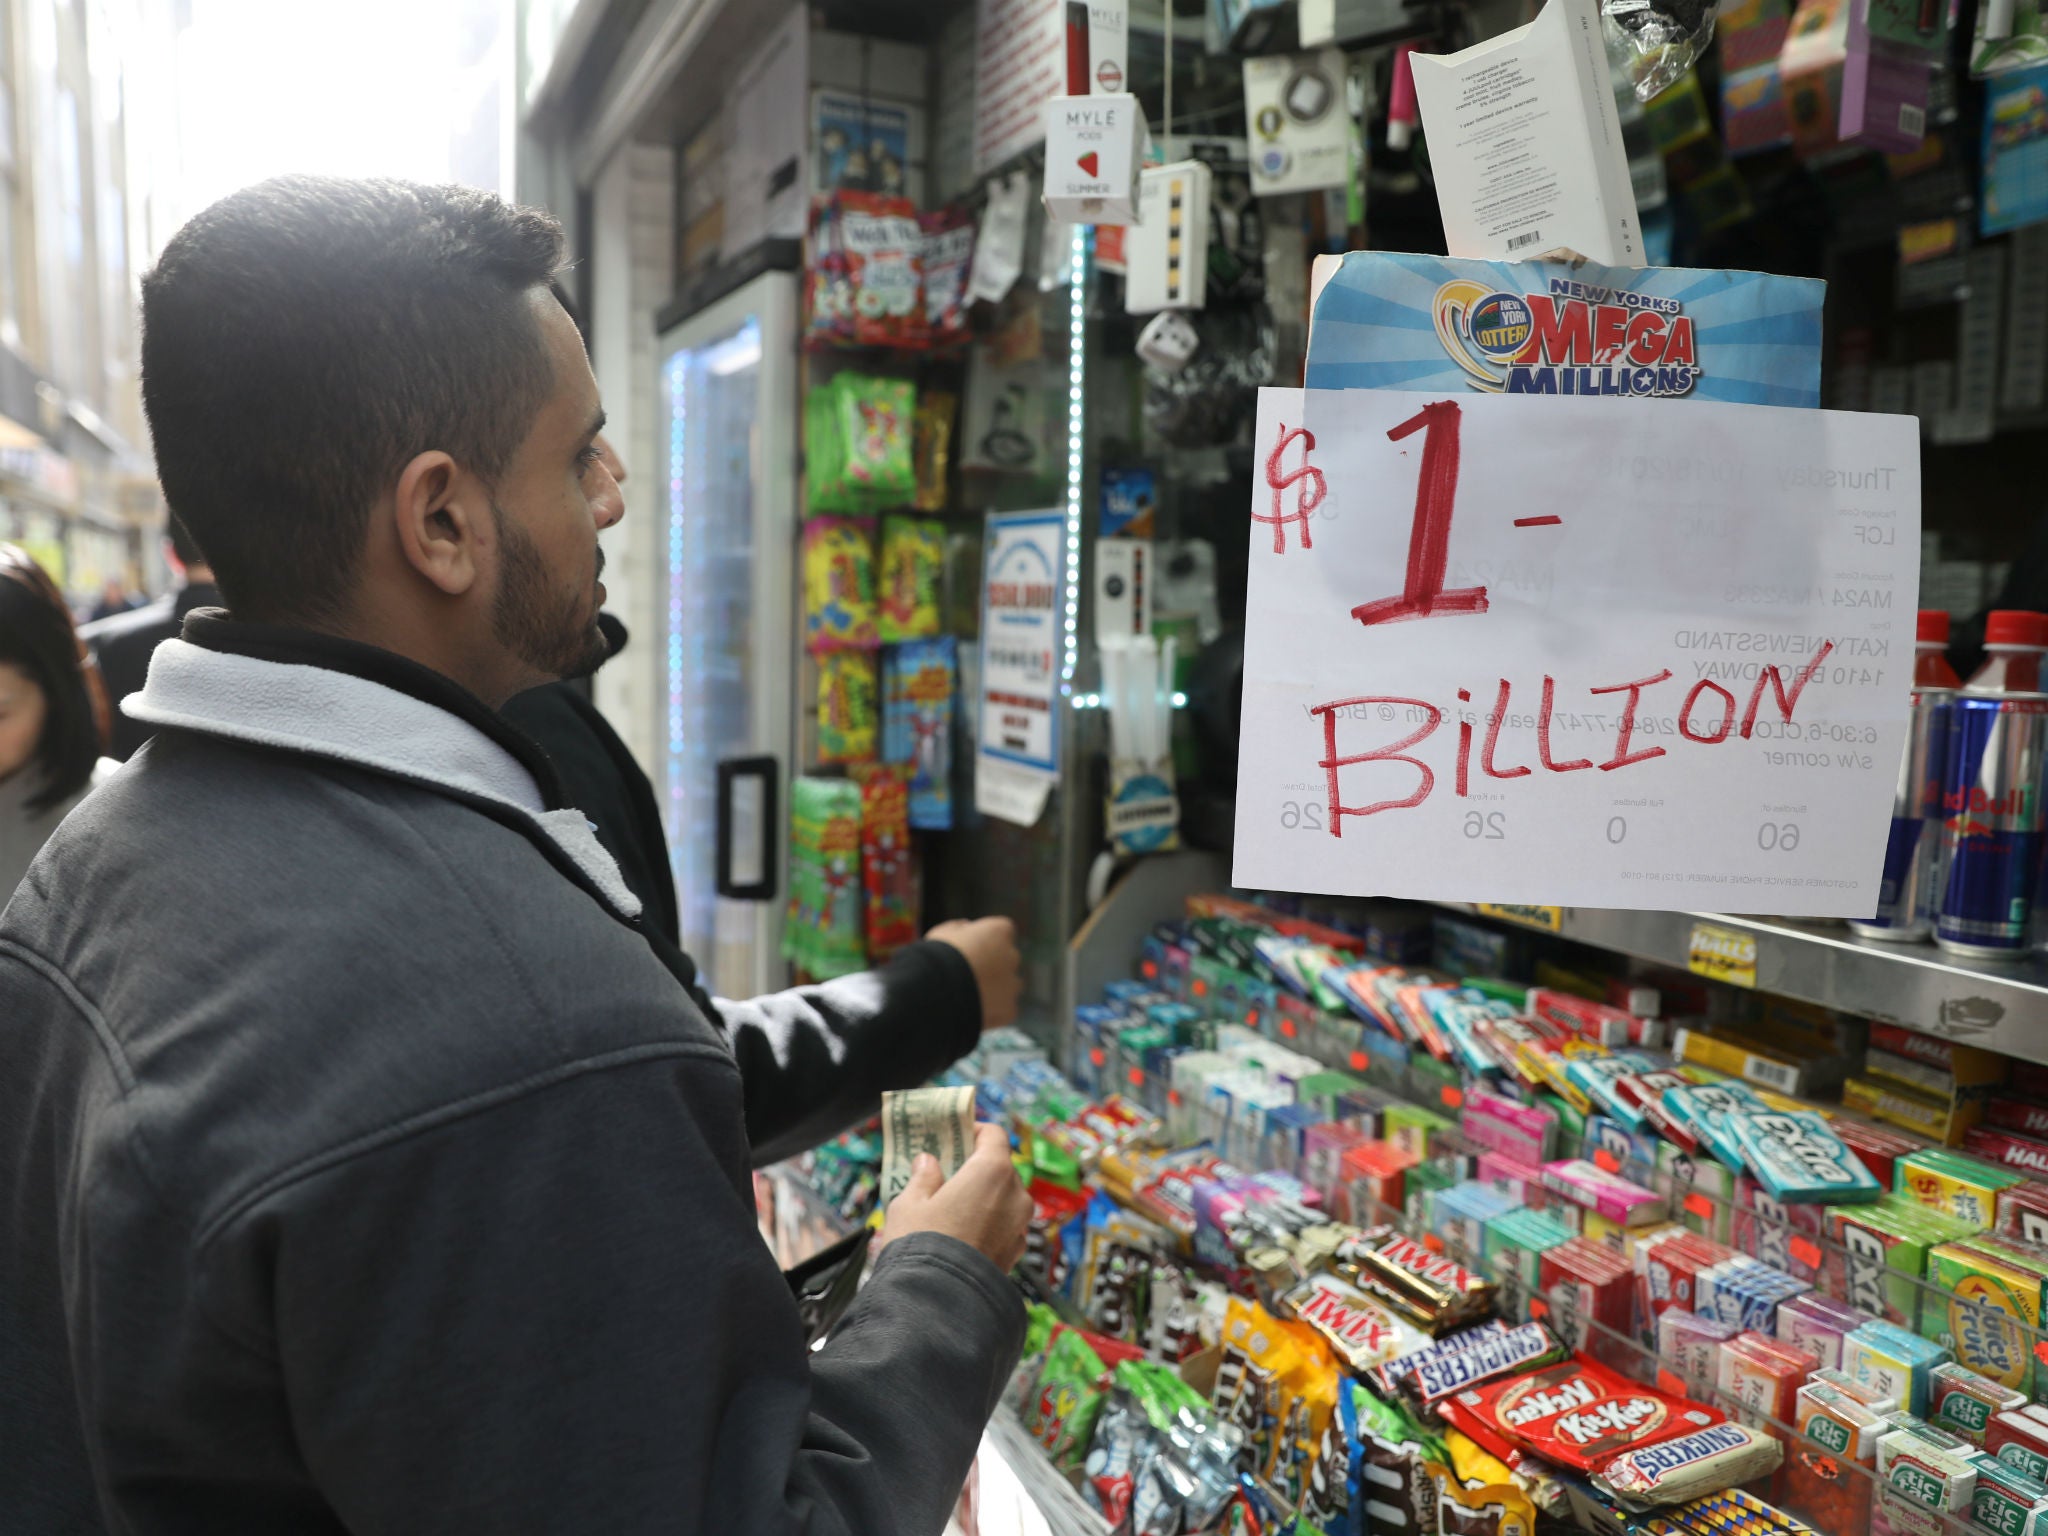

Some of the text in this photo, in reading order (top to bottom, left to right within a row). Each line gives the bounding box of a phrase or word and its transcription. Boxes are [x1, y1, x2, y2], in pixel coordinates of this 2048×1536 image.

[1463, 120, 1475, 128] year
[1475, 113, 1494, 123] limited
[1494, 105, 1513, 115] device
[1513, 96, 1539, 109] warranty
[1500, 300, 1520, 311] NEW
[1550, 279, 1679, 313] NEW YORK'S
[1501, 310, 1527, 326] YORK
[1515, 295, 1694, 364] MEGA
[1477, 324, 1528, 347] LOTTERY
[1508, 366, 1693, 397] MILLIONS
[1969, 786, 2024, 816] Bull
[1420, 1325, 1543, 1396] SNICKERS
[1950, 1403, 1981, 1429] tac
[1959, 1397, 1983, 1419] tic
[1813, 1427, 1842, 1452] tac
[1820, 1416, 1844, 1442] tic
[1633, 1423, 1746, 1482] SNICKERS
[2013, 1448, 2042, 1473] tic
[1907, 1470, 1937, 1497] tic
[1976, 1503, 2017, 1536] tac
[1986, 1495, 2019, 1525] tic
